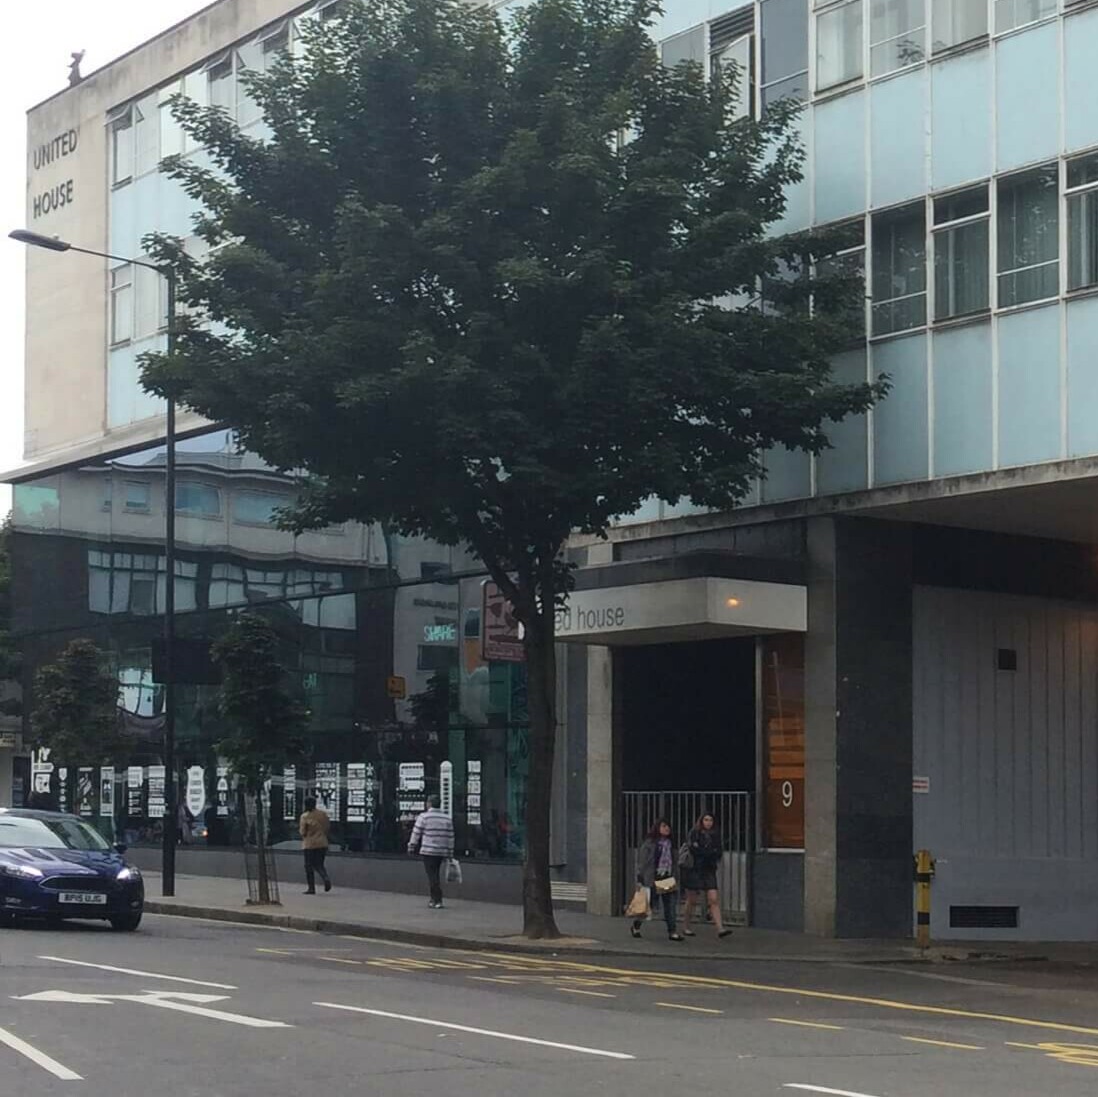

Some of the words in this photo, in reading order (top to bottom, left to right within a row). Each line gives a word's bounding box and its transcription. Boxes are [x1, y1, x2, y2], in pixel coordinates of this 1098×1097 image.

[33, 129, 78, 170] UNITED
[33, 179, 73, 219] HOUSE
[577, 606, 625, 629] house
[782, 781, 793, 807] 9
